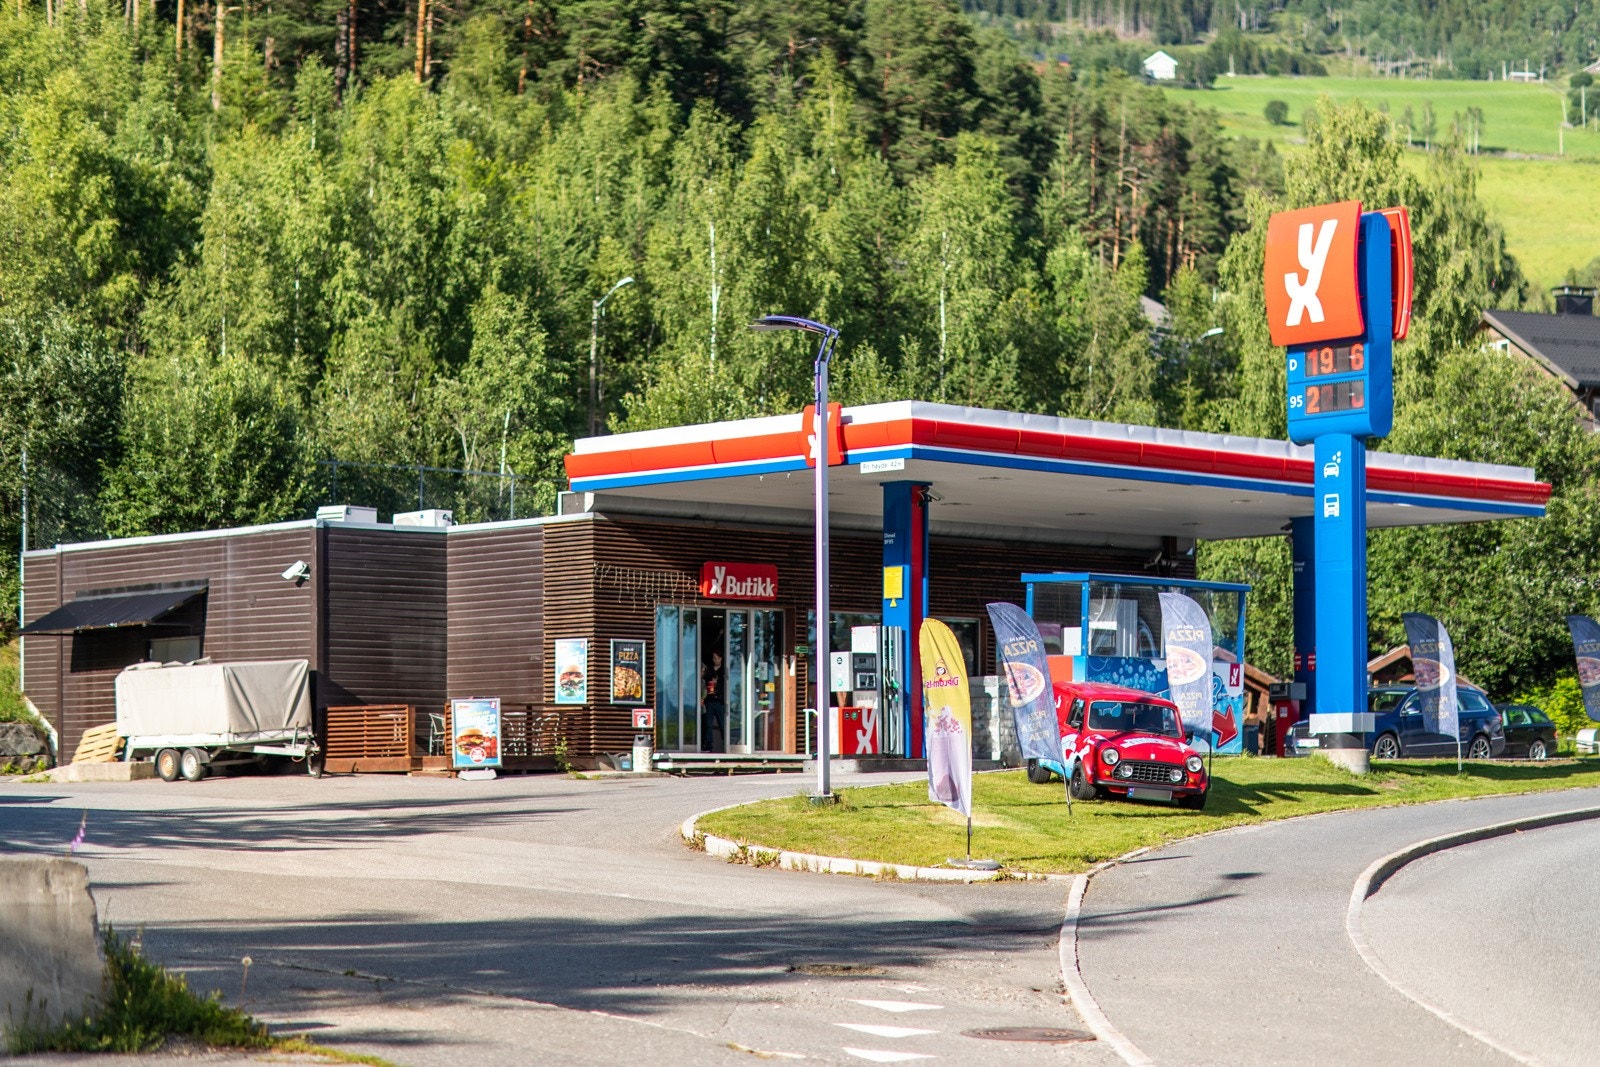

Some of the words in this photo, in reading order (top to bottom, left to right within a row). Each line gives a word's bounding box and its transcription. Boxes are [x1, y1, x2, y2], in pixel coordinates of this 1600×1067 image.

[1289, 359, 1297, 371] D
[1290, 395, 1303, 408] 95
[726, 575, 775, 597] Butikk
[618, 651, 639, 661] PIZZA
